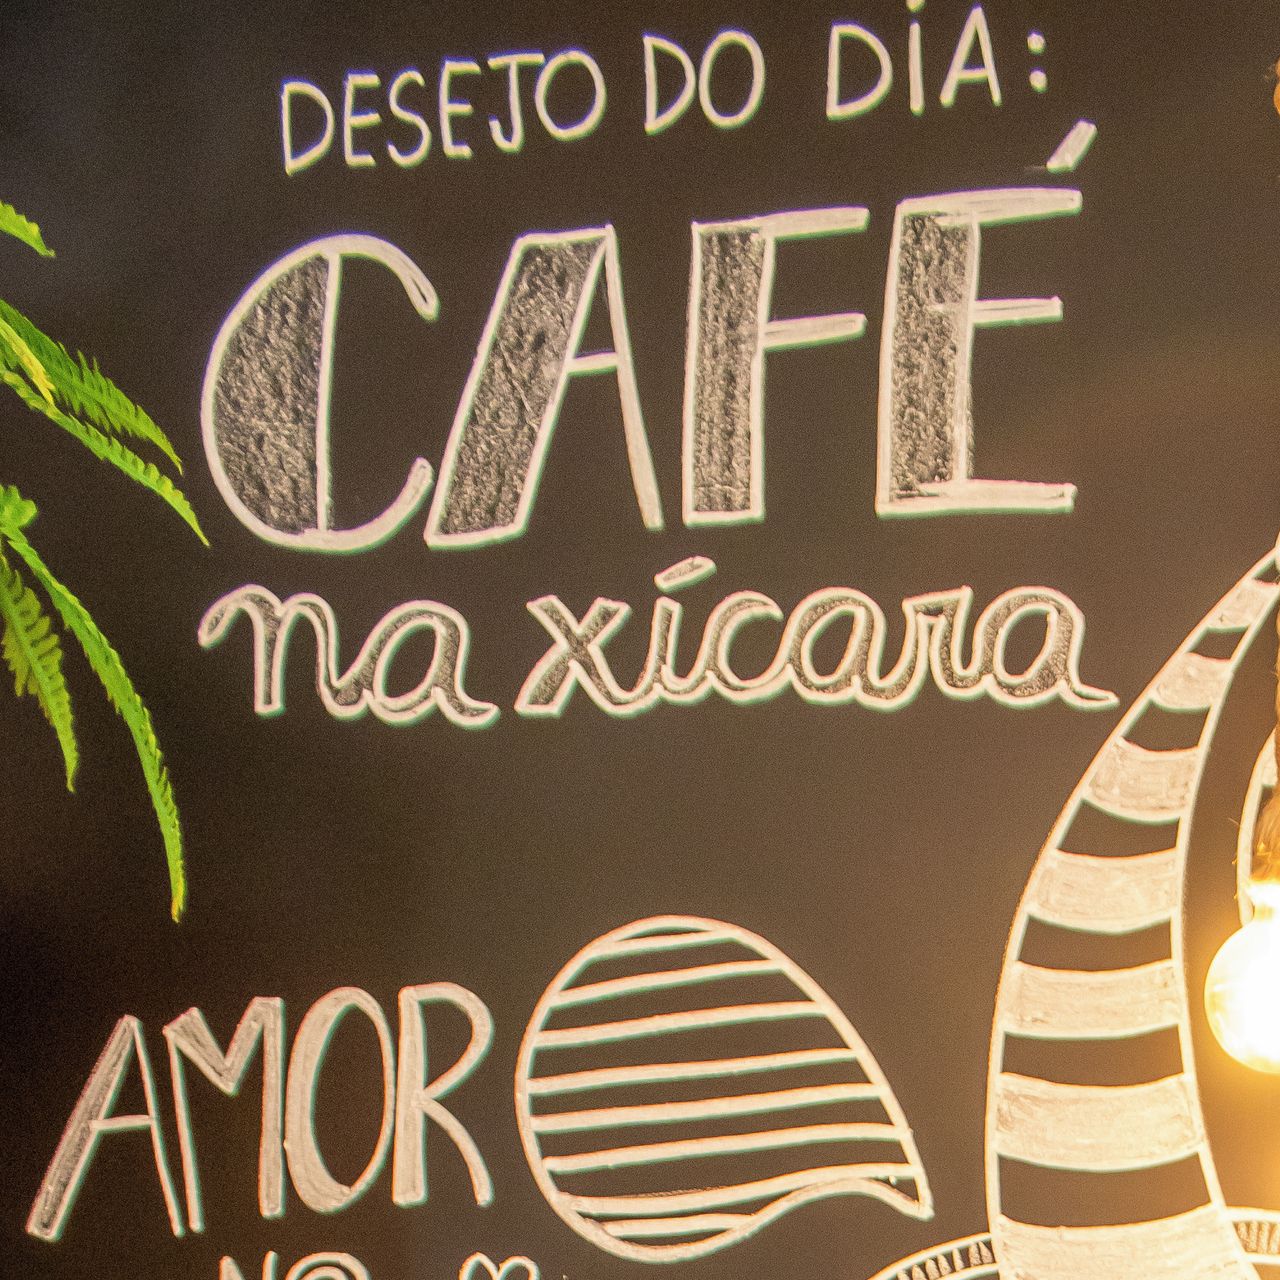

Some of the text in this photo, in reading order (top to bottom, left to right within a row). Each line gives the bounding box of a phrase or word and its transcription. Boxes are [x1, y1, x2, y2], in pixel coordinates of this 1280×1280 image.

[281, 49, 607, 176] DESEJO
[642, 29, 767, 135] DO
[200, 119, 1097, 552] CAFÉ
[198, 555, 1120, 726] na xícara
[25, 980, 496, 1242] AMOR
